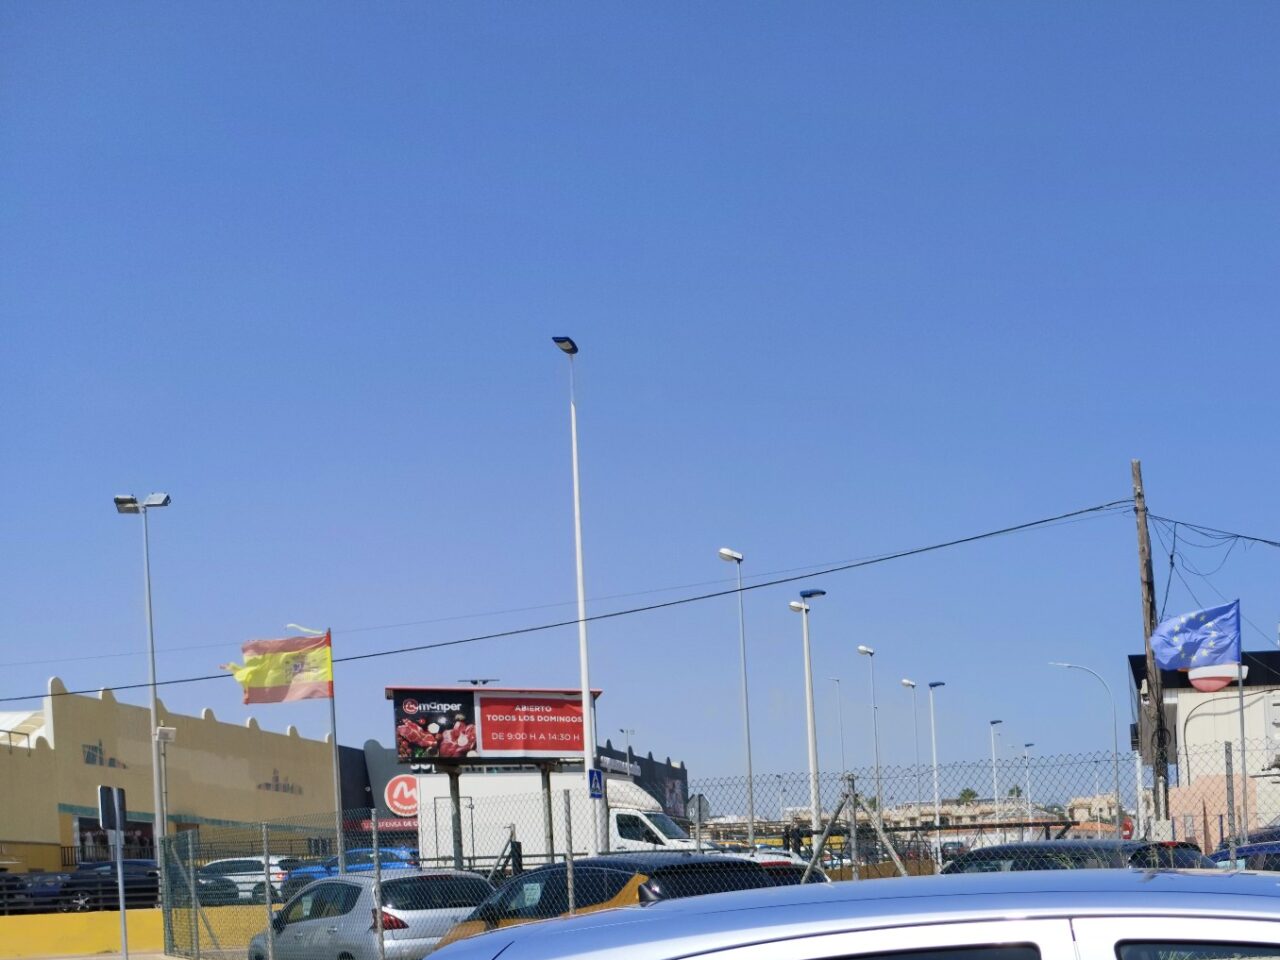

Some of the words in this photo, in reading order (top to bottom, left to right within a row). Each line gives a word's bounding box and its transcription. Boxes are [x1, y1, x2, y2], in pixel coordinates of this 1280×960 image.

[514, 704, 552, 712] ABIERTO
[537, 715, 583, 723] DOMINGOS
[492, 732, 505, 740] DE
